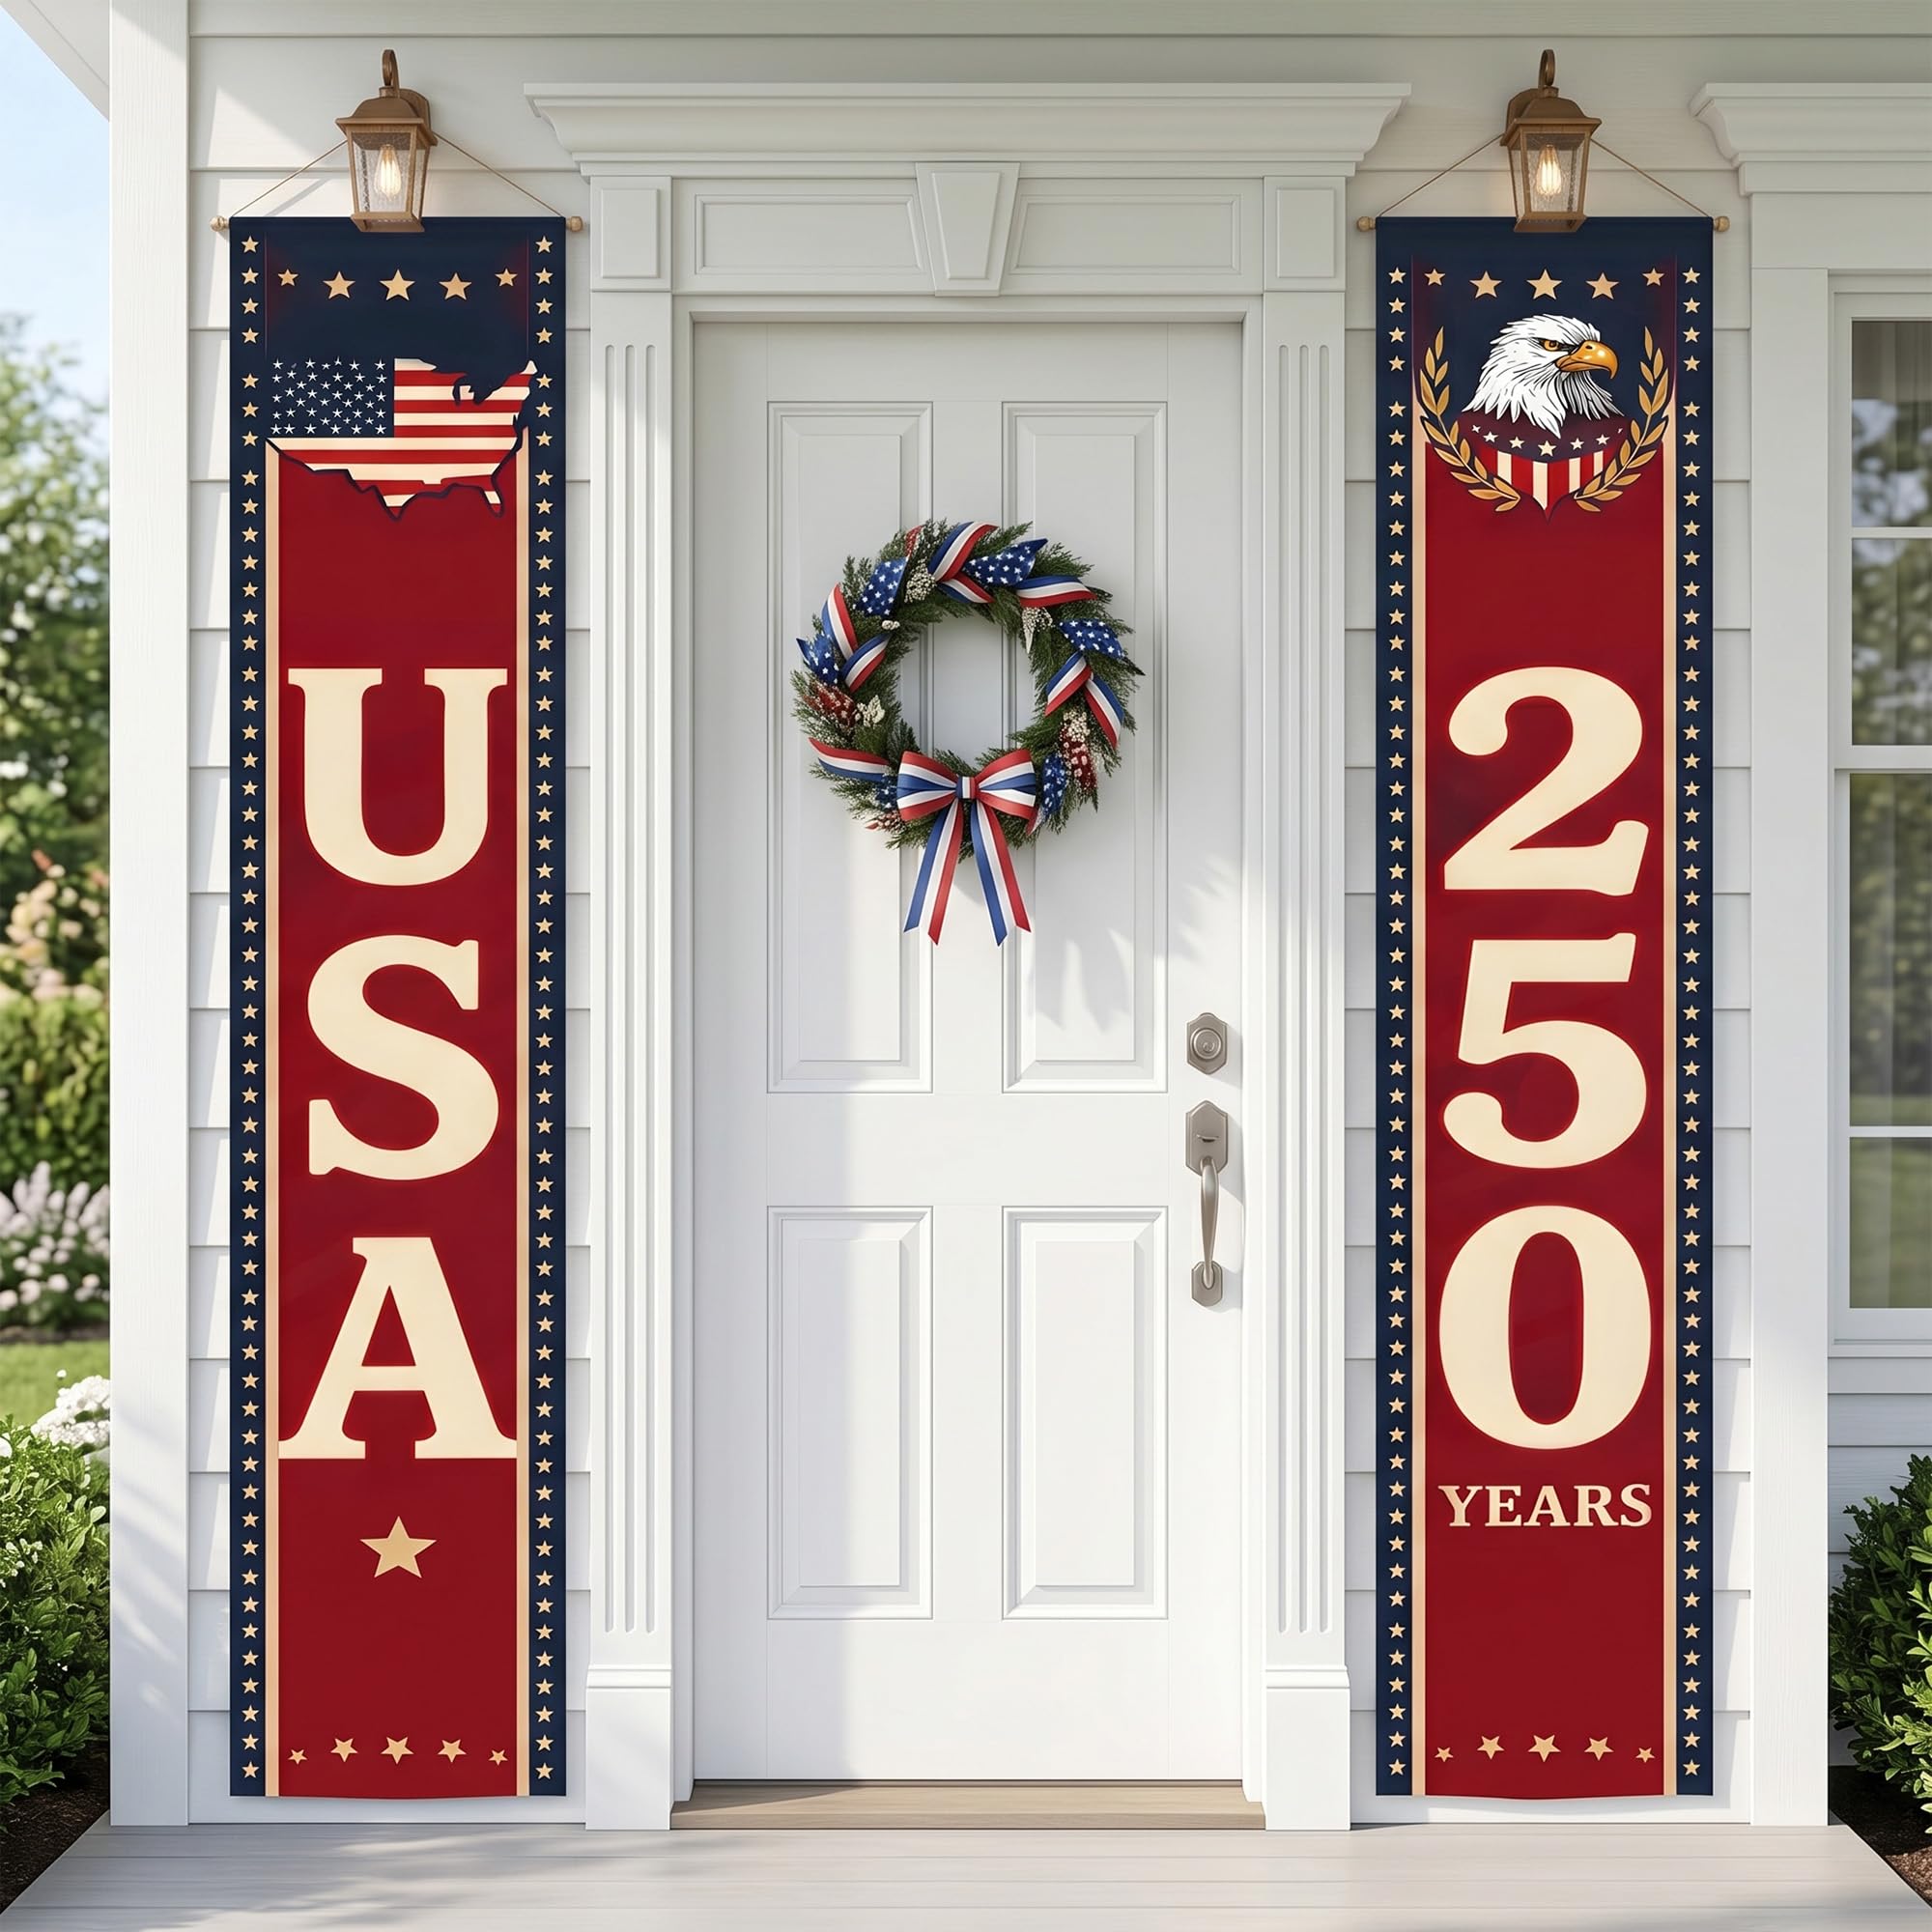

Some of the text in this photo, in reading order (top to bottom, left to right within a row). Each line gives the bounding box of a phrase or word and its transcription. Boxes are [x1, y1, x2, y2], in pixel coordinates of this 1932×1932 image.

[279, 668, 517, 1461] USA
[1439, 667, 1652, 1450] 250
[1437, 1483, 1653, 1527] YEARS
